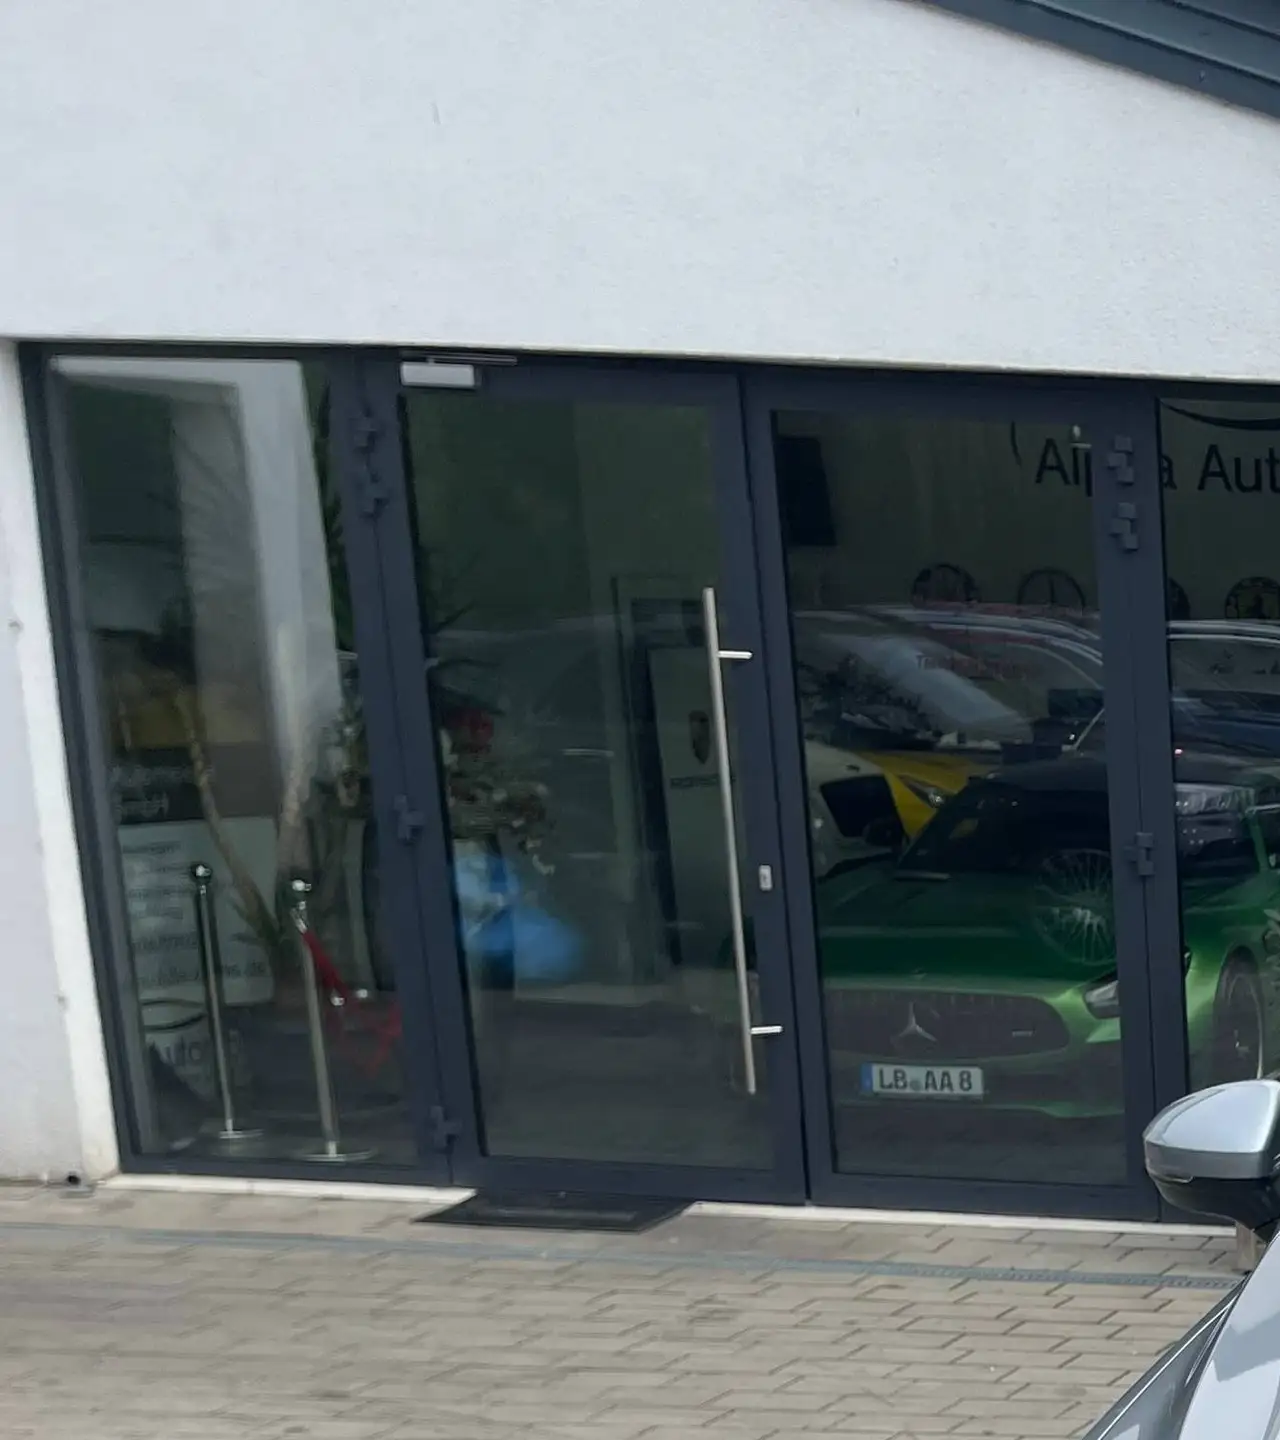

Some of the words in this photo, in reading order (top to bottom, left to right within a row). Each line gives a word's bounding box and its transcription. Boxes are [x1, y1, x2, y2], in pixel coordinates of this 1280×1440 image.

[1034, 437, 1178, 497] Ala
[878, 1067, 908, 1090] LB
[924, 1069, 954, 1092] AA
[959, 1070, 973, 1092] 8
